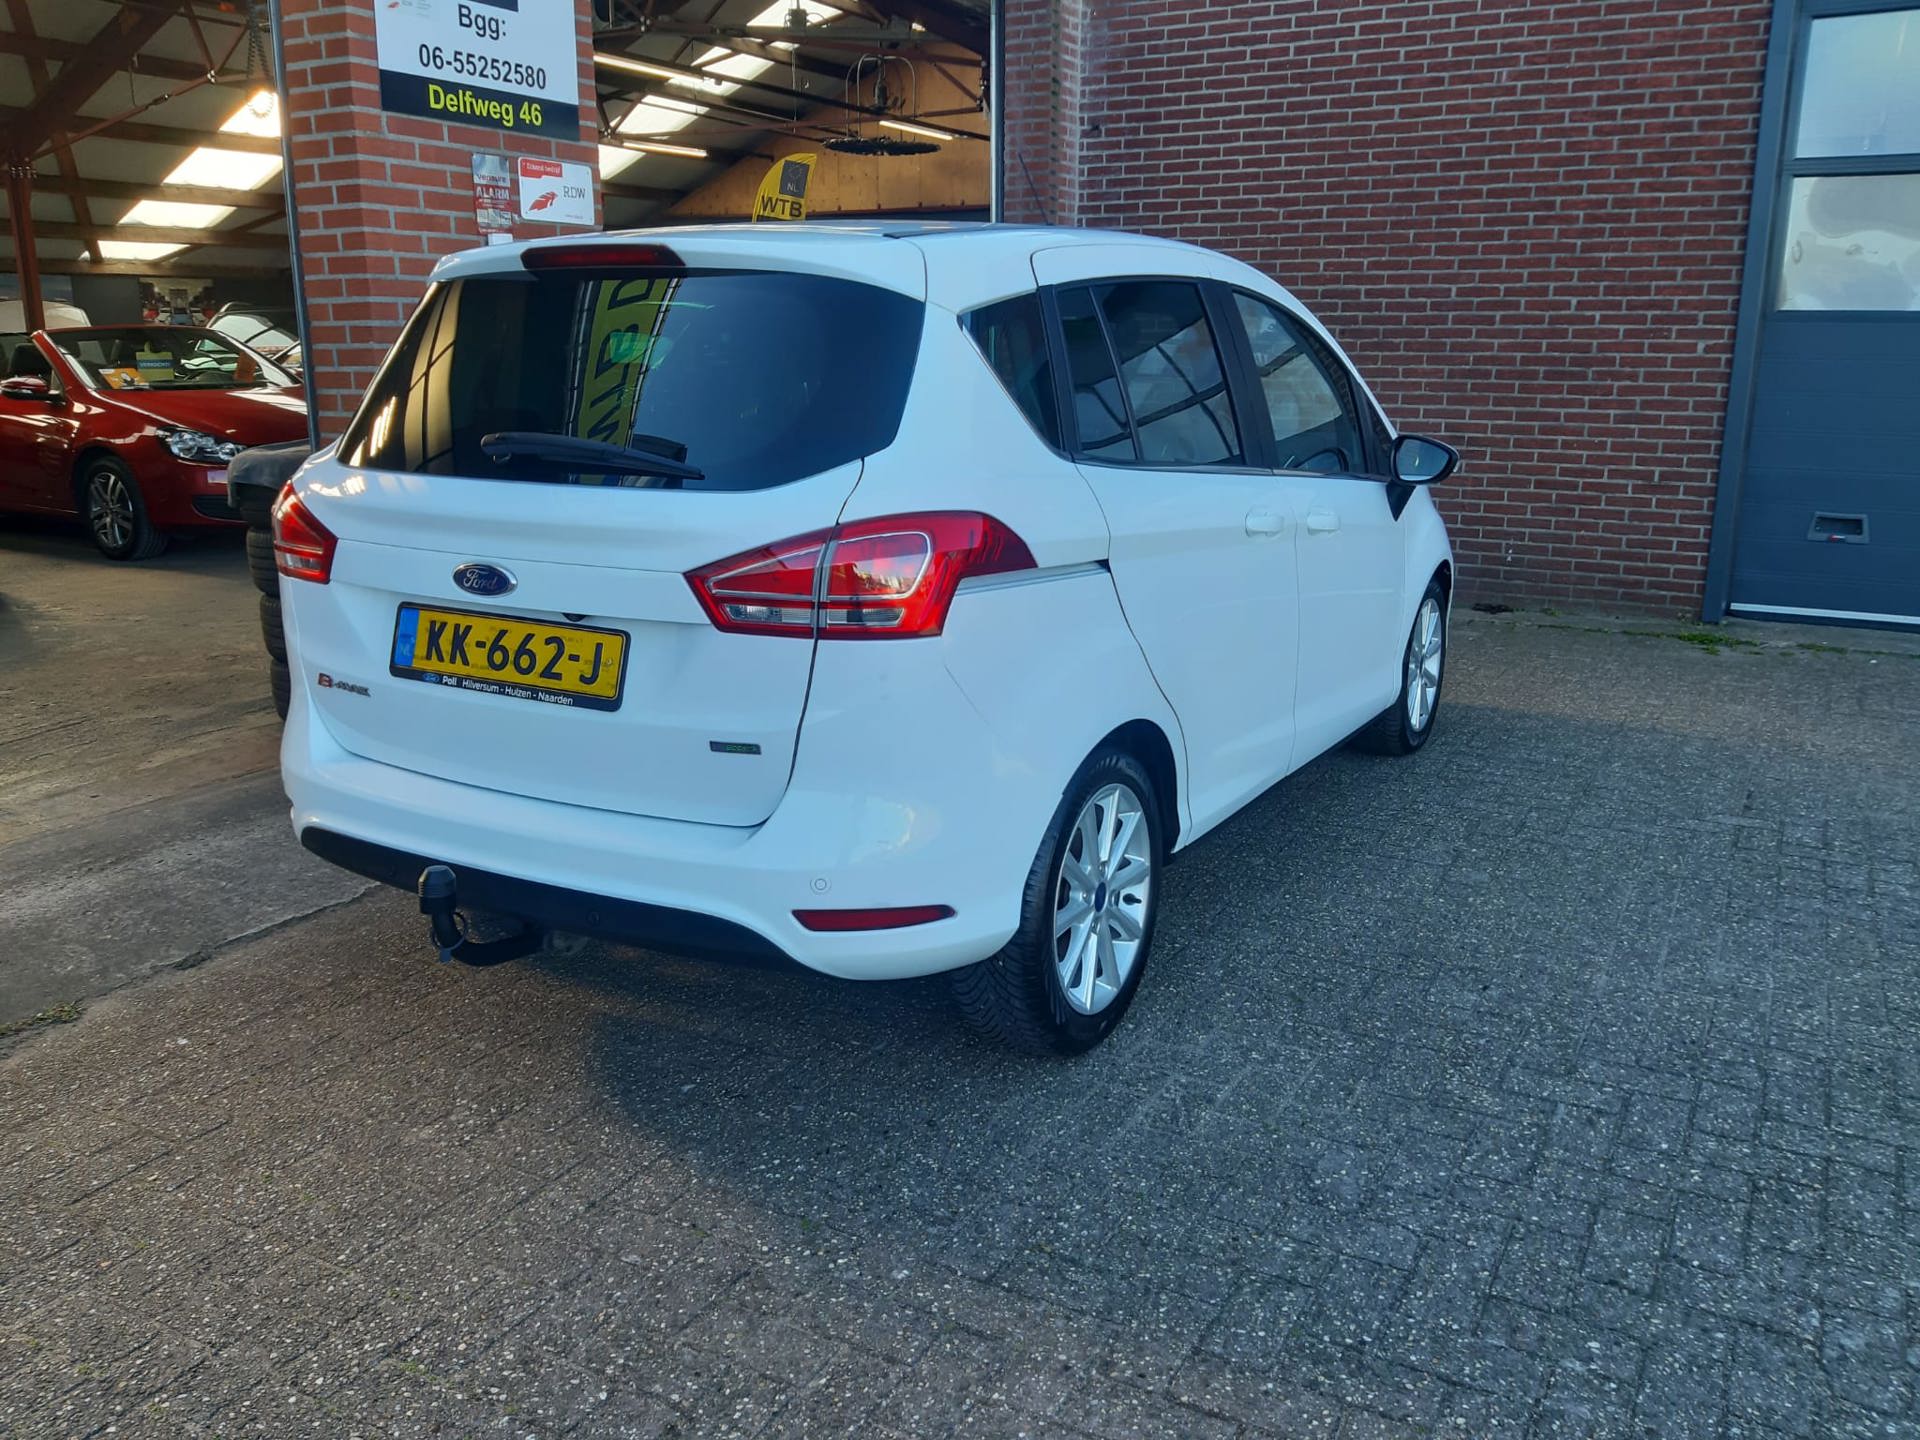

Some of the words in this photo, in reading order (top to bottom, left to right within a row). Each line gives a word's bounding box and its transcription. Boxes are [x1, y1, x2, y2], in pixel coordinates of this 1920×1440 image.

[458, 4, 507, 40] Bgg:
[418, 43, 547, 91] 06-55252580
[428, 83, 514, 128] Delfweg
[519, 101, 543, 127] 46
[476, 186, 510, 201] ALARM
[563, 186, 586, 200] RDW
[787, 182, 800, 193] NL
[761, 195, 803, 218] WTB
[463, 568, 498, 590] Ford
[425, 619, 603, 686] KK-662-J
[442, 676, 458, 687] Poll
[462, 679, 499, 694] Hilversum
[505, 686, 532, 700] Huizen
[538, 691, 574, 706] Naarden
